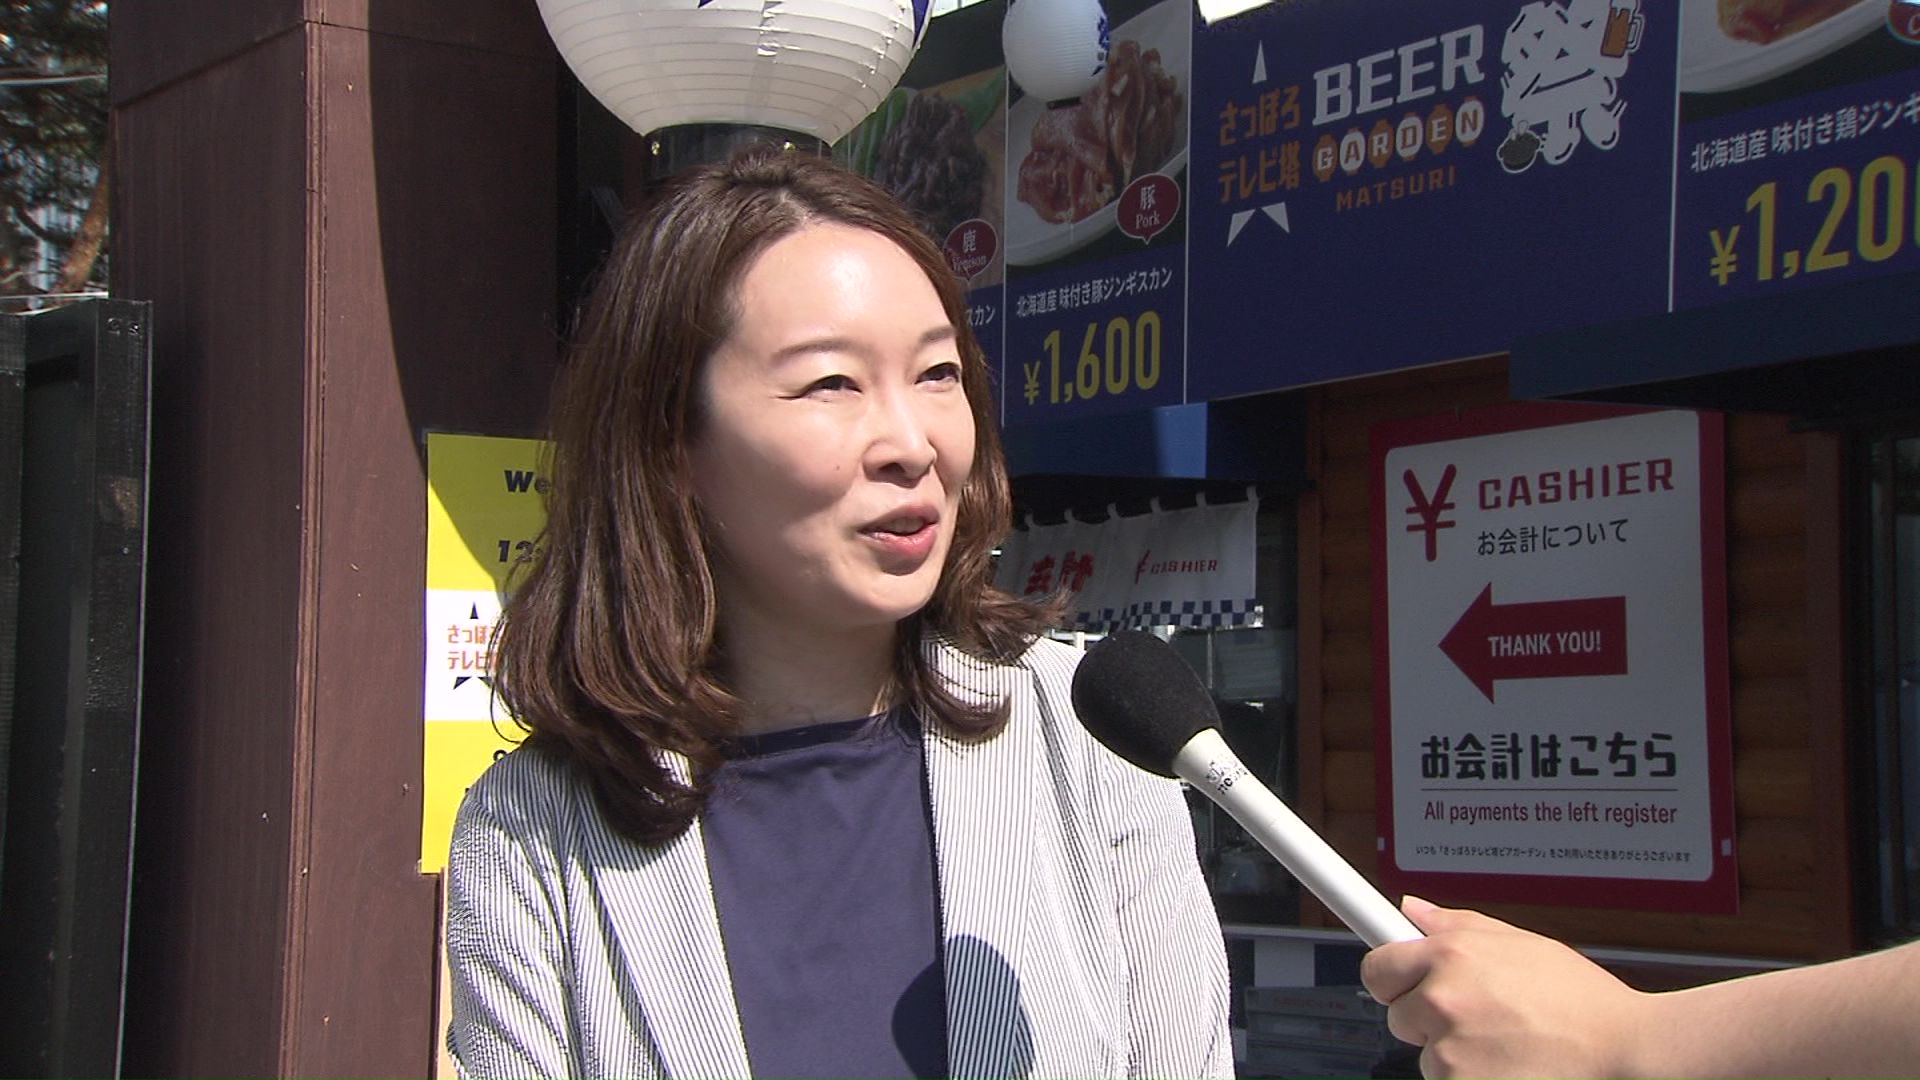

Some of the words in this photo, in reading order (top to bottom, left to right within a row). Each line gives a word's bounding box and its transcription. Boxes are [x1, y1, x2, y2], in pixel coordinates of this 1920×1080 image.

[1312, 25, 1486, 126] BEER
[1219, 85, 1301, 146] さっぽろ
[1314, 99, 1484, 178] GARDEN
[1691, 129, 1767, 173] 北海道産
[1218, 141, 1301, 203] テレビ塔
[1336, 165, 1456, 212] MATSURI
[1139, 184, 1156, 211] 豚
[962, 228, 978, 254] 鹿
[1135, 211, 1161, 230] Pork
[1709, 155, 1920, 287] ¥1,20
[1016, 287, 1058, 318] 北海道産
[1023, 310, 1161, 406] ¥1,600
[1478, 458, 1675, 511] CASHIER
[1478, 518, 1629, 556] お会計について
[1151, 559, 1217, 575] CASHIER
[447, 624, 496, 646] さっぽ
[1488, 633, 1551, 658] THANK
[1556, 629, 1601, 654] YOU!
[1421, 731, 1677, 781] お会計はこちら
[1424, 801, 1444, 820] All
[1450, 802, 1528, 825] payments
[1535, 802, 1562, 821] the
[1568, 802, 1599, 822] left
[1604, 804, 1678, 828] register
